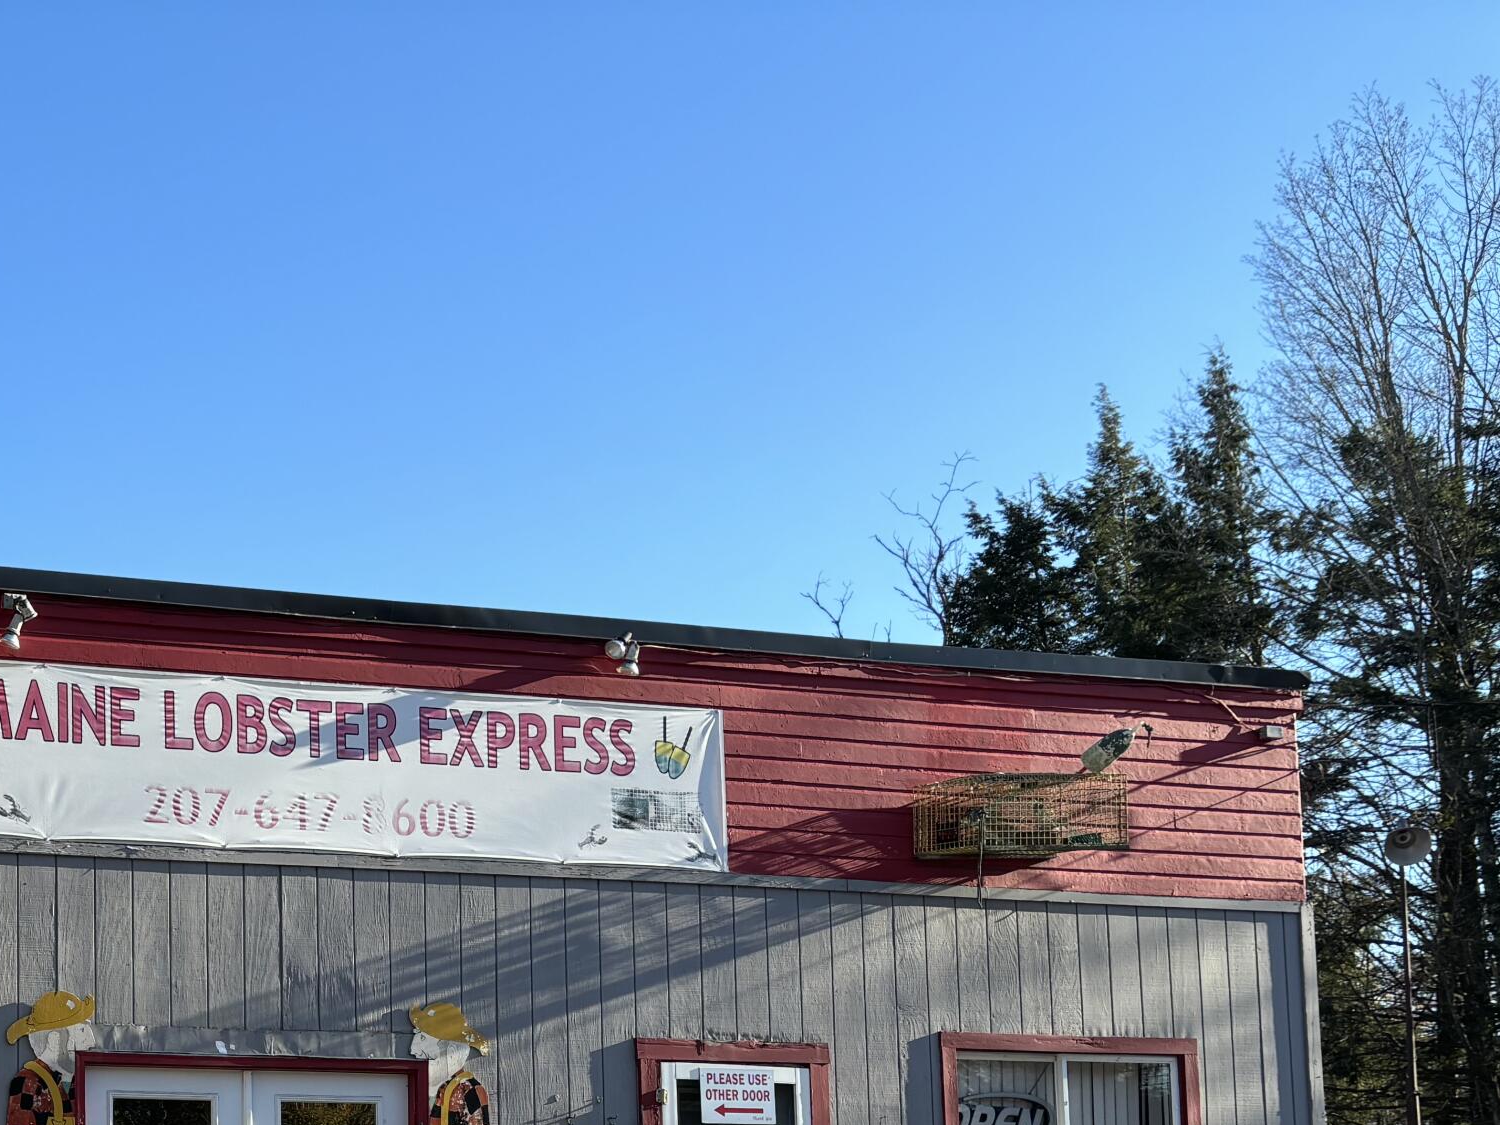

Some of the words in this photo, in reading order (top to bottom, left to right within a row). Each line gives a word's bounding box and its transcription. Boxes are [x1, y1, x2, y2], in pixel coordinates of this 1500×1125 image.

[163, 690, 402, 763] LOBSTER
[419, 706, 637, 777] EXPRESS
[706, 1073, 745, 1085] PLEASE
[748, 1074, 768, 1086] USE
[705, 1088, 739, 1101] OTHER
[742, 1090, 771, 1102] DOOR
